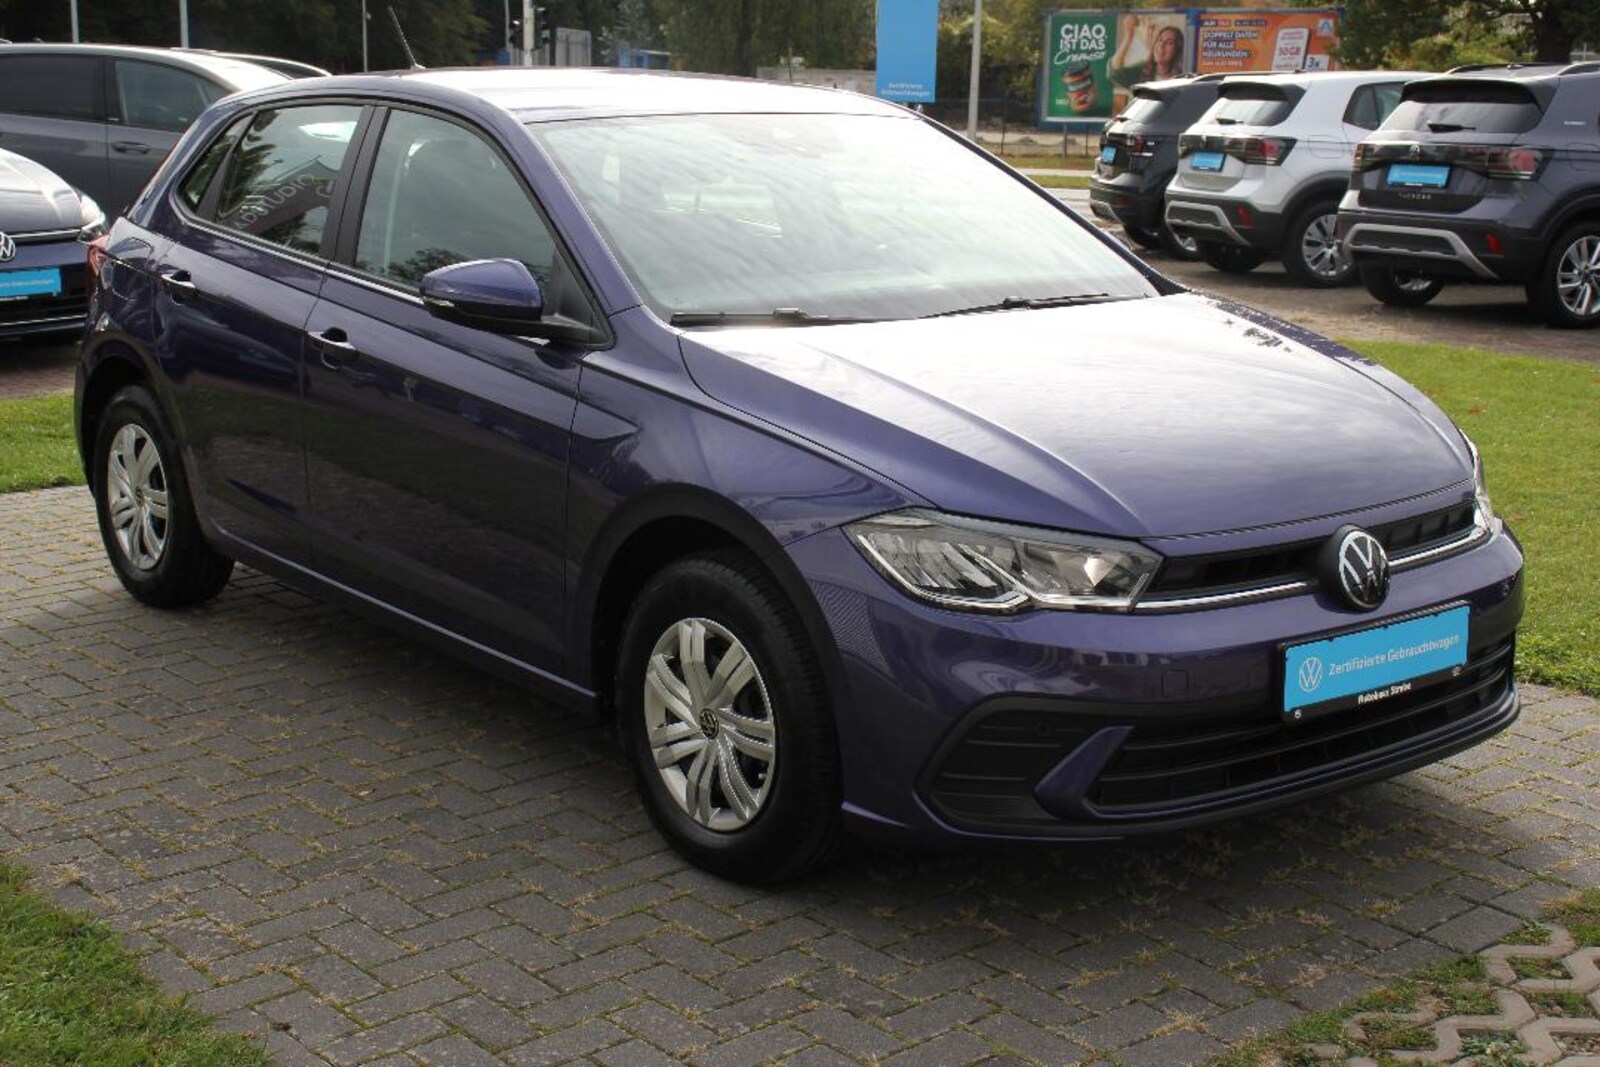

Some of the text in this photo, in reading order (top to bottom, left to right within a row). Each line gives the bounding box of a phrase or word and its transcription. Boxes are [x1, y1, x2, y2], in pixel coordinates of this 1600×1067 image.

[1060, 38, 1106, 50] IST DAS
[1328, 634, 1460, 676] Zertifizierte Gebrauchtwagen
